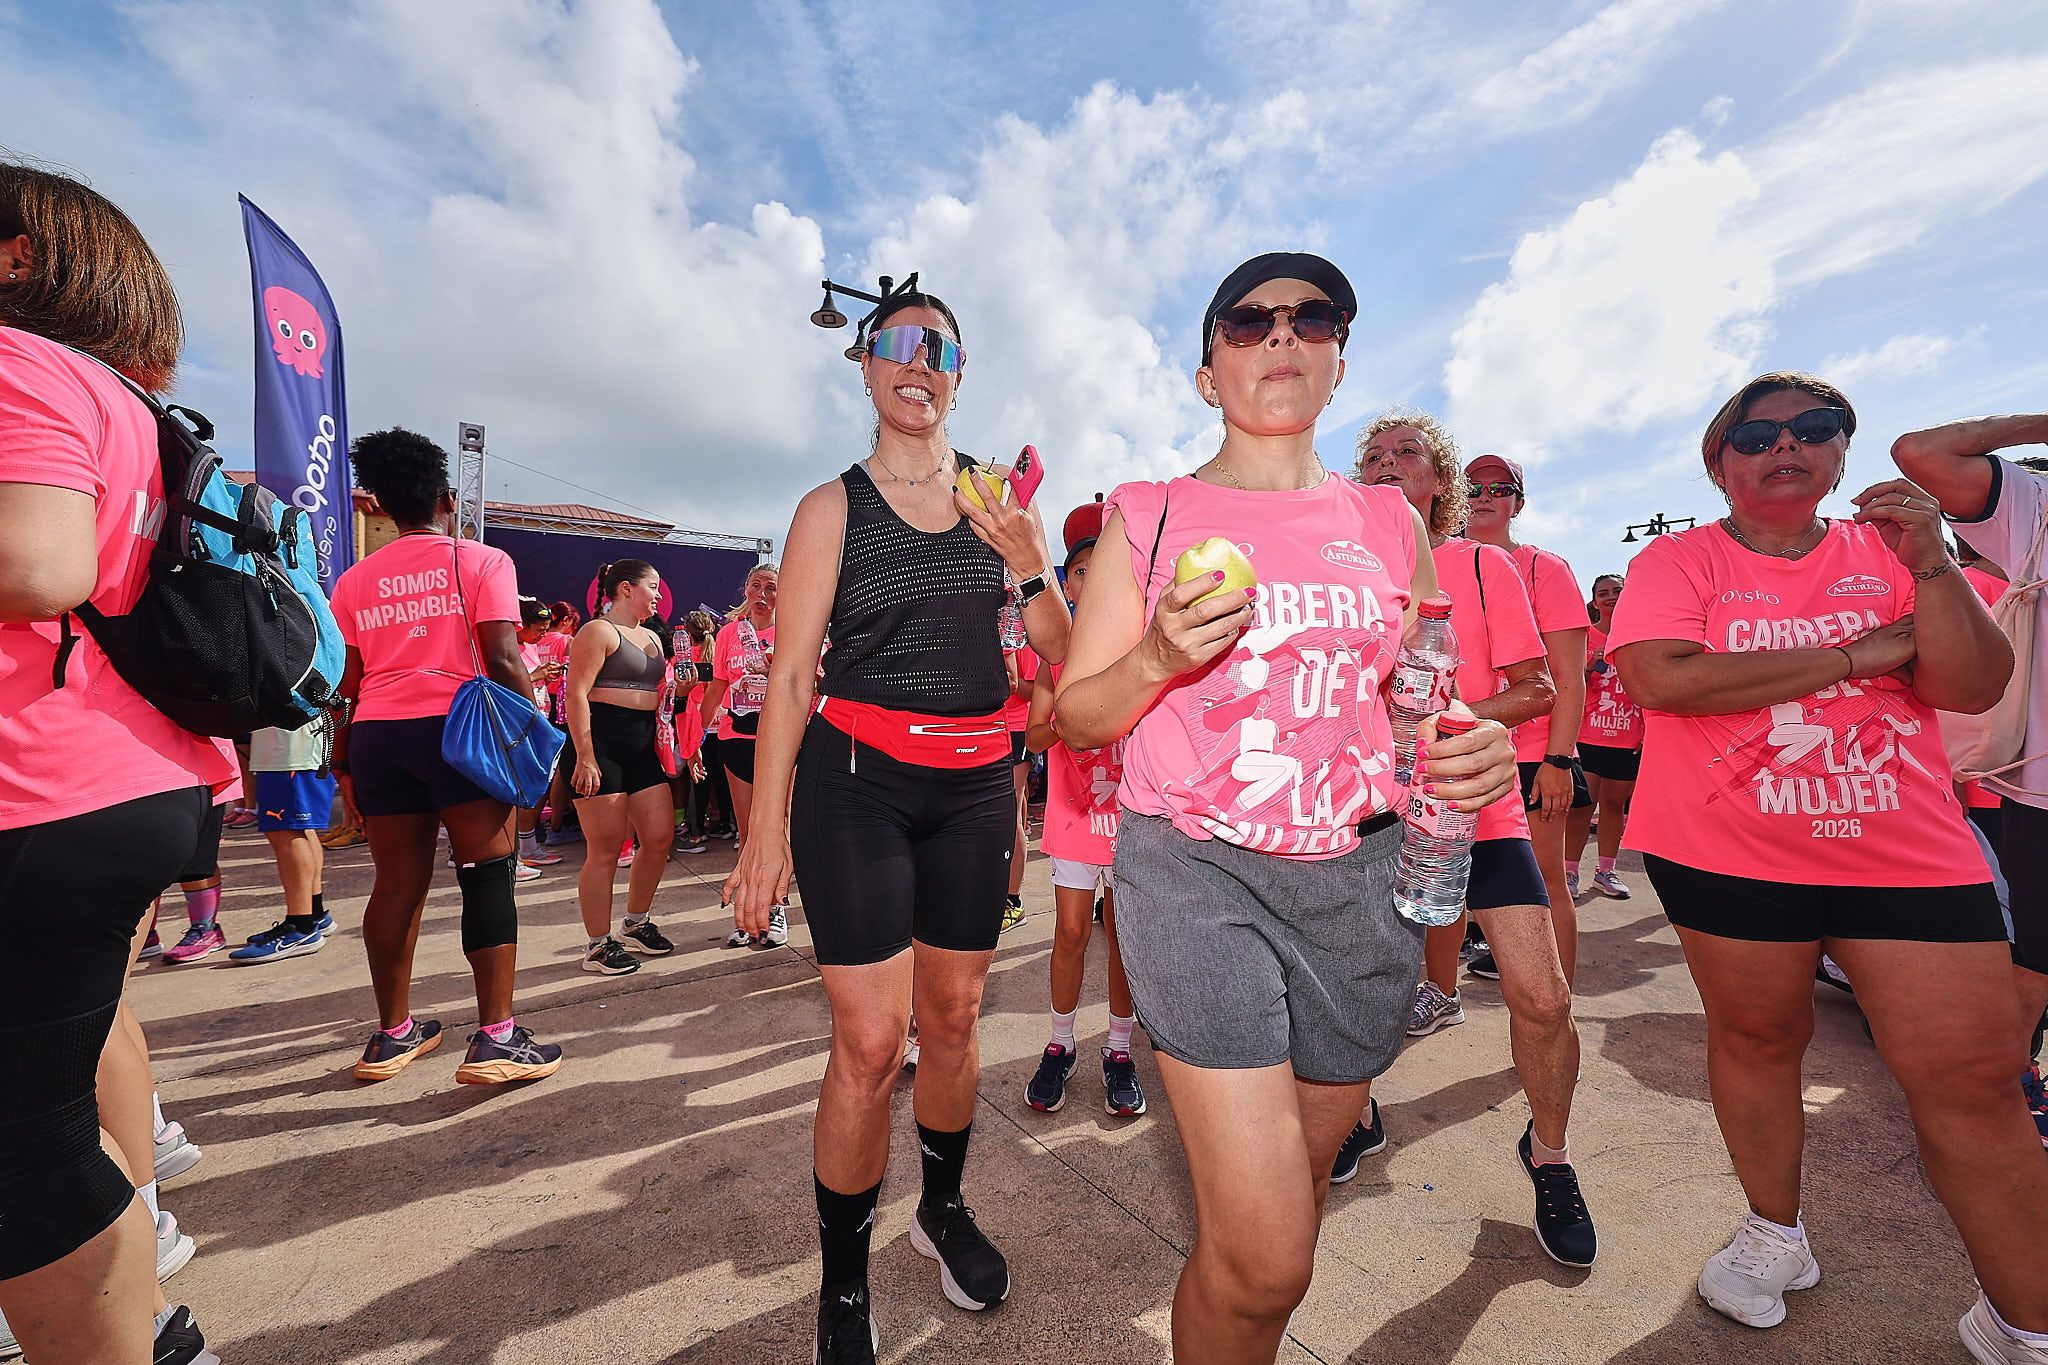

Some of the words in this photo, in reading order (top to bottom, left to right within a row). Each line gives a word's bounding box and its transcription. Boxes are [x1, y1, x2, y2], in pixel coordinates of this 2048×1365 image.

[1327, 548, 1379, 569] ASTURIANA
[378, 567, 448, 598] SOMOS
[1721, 590, 1780, 605] OYSHO
[1251, 581, 1385, 632] RRERA
[1726, 608, 1881, 652] CARRERA
[1290, 647, 1361, 718] DE
[1590, 715, 1631, 730] MUJER
[1822, 725, 1869, 773] LA
[1288, 759, 1333, 826] LA
[1757, 773, 1900, 815] MUJER
[1811, 819, 1862, 838] 2026
